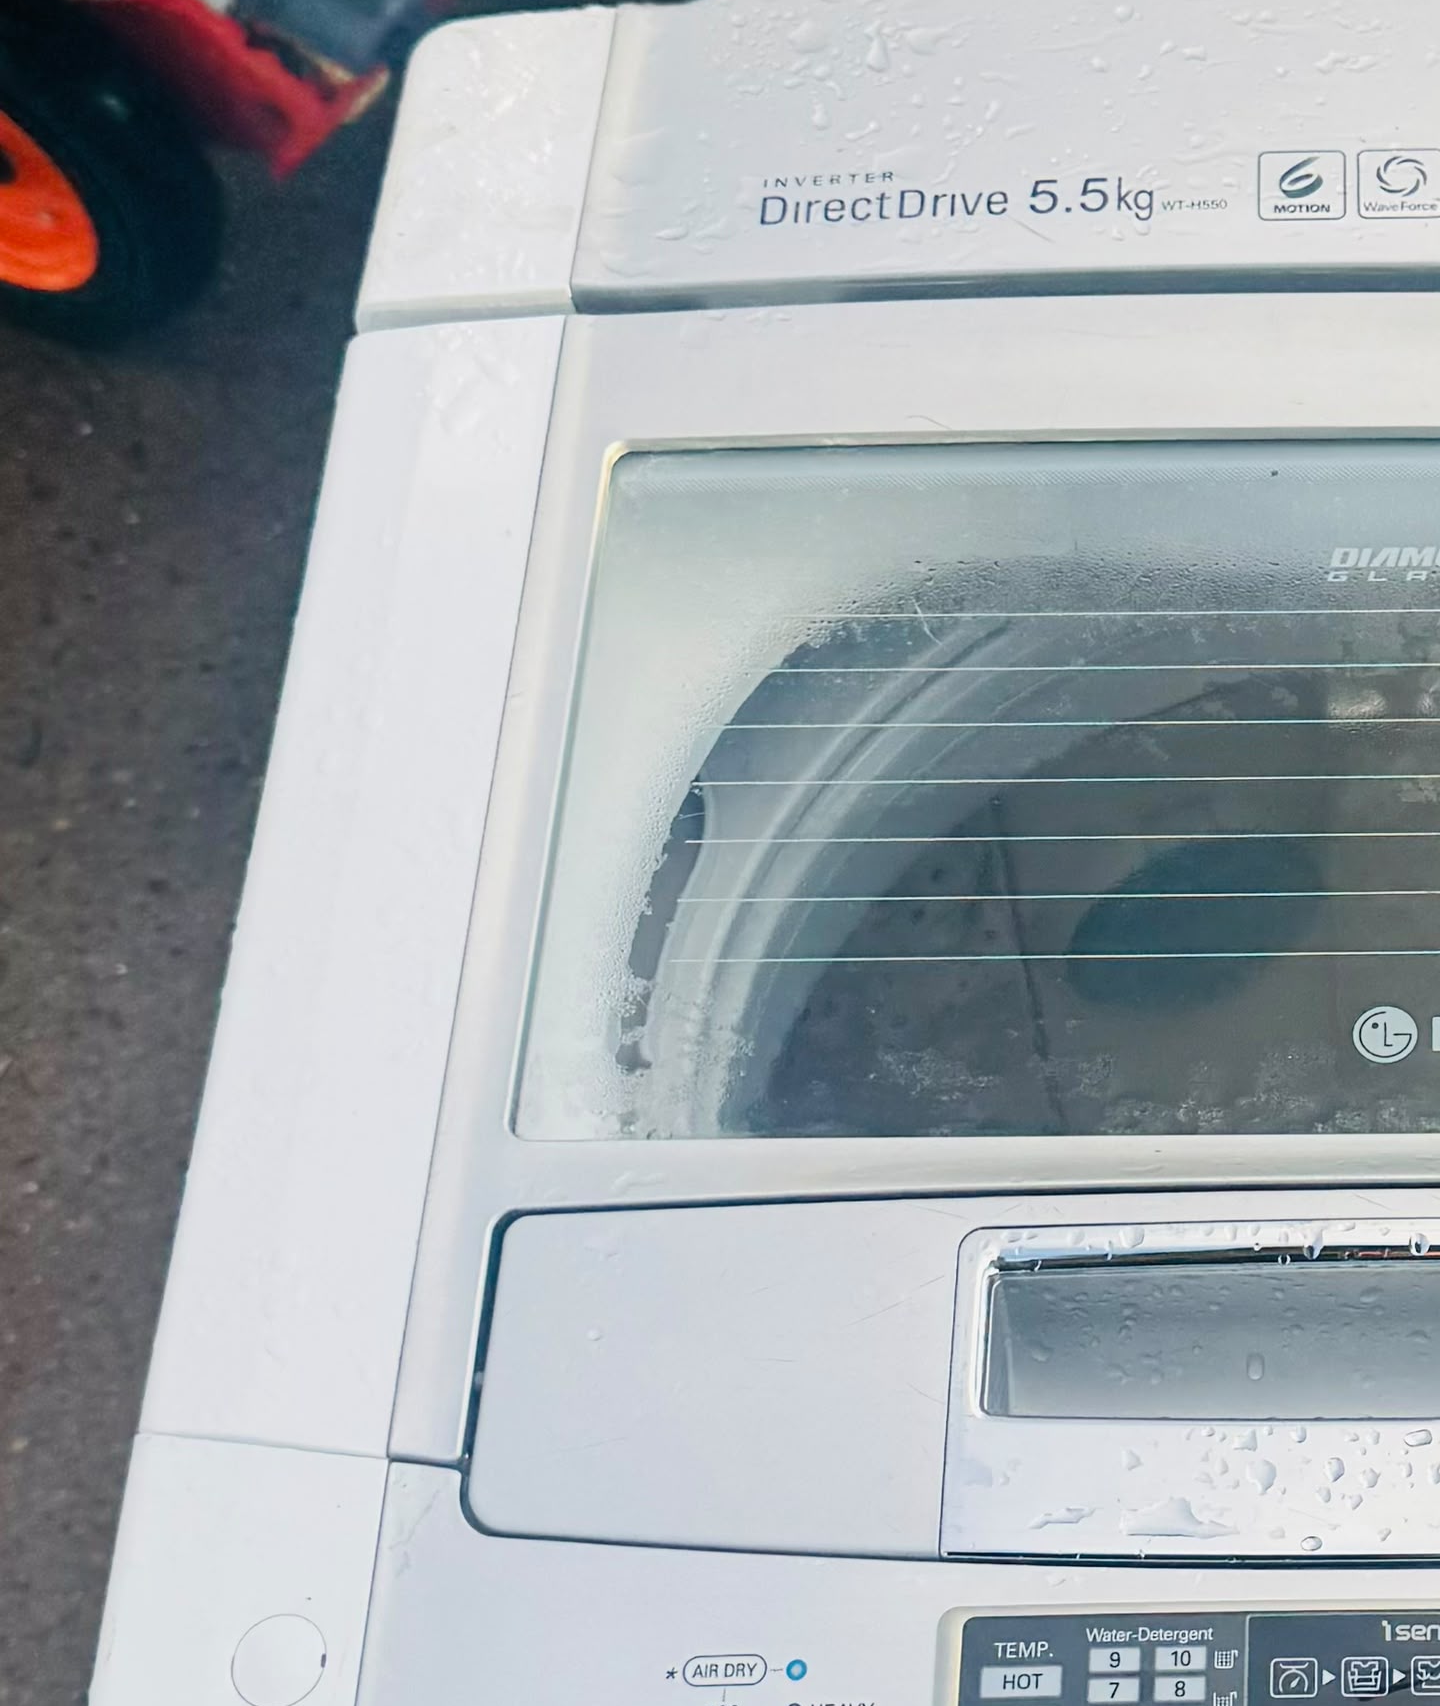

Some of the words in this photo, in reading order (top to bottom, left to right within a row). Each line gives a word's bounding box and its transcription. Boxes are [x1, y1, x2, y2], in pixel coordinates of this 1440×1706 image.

[763, 171, 895, 188] INVERTER
[1028, 176, 1154, 221] 5.5kg
[1273, 203, 1331, 214] MOTION
[1086, 1626, 1214, 1643] Water-Detergent
[994, 1641, 1054, 1659] TEMP.
[1170, 1650, 1191, 1667] 10
[1108, 1651, 1121, 1668] 9
[692, 1663, 719, 1679] AIR
[724, 1662, 758, 1678] DRY
[1002, 1673, 1044, 1690] HOT
[1174, 1680, 1186, 1698] 8
[1108, 1682, 1120, 1699] 7
